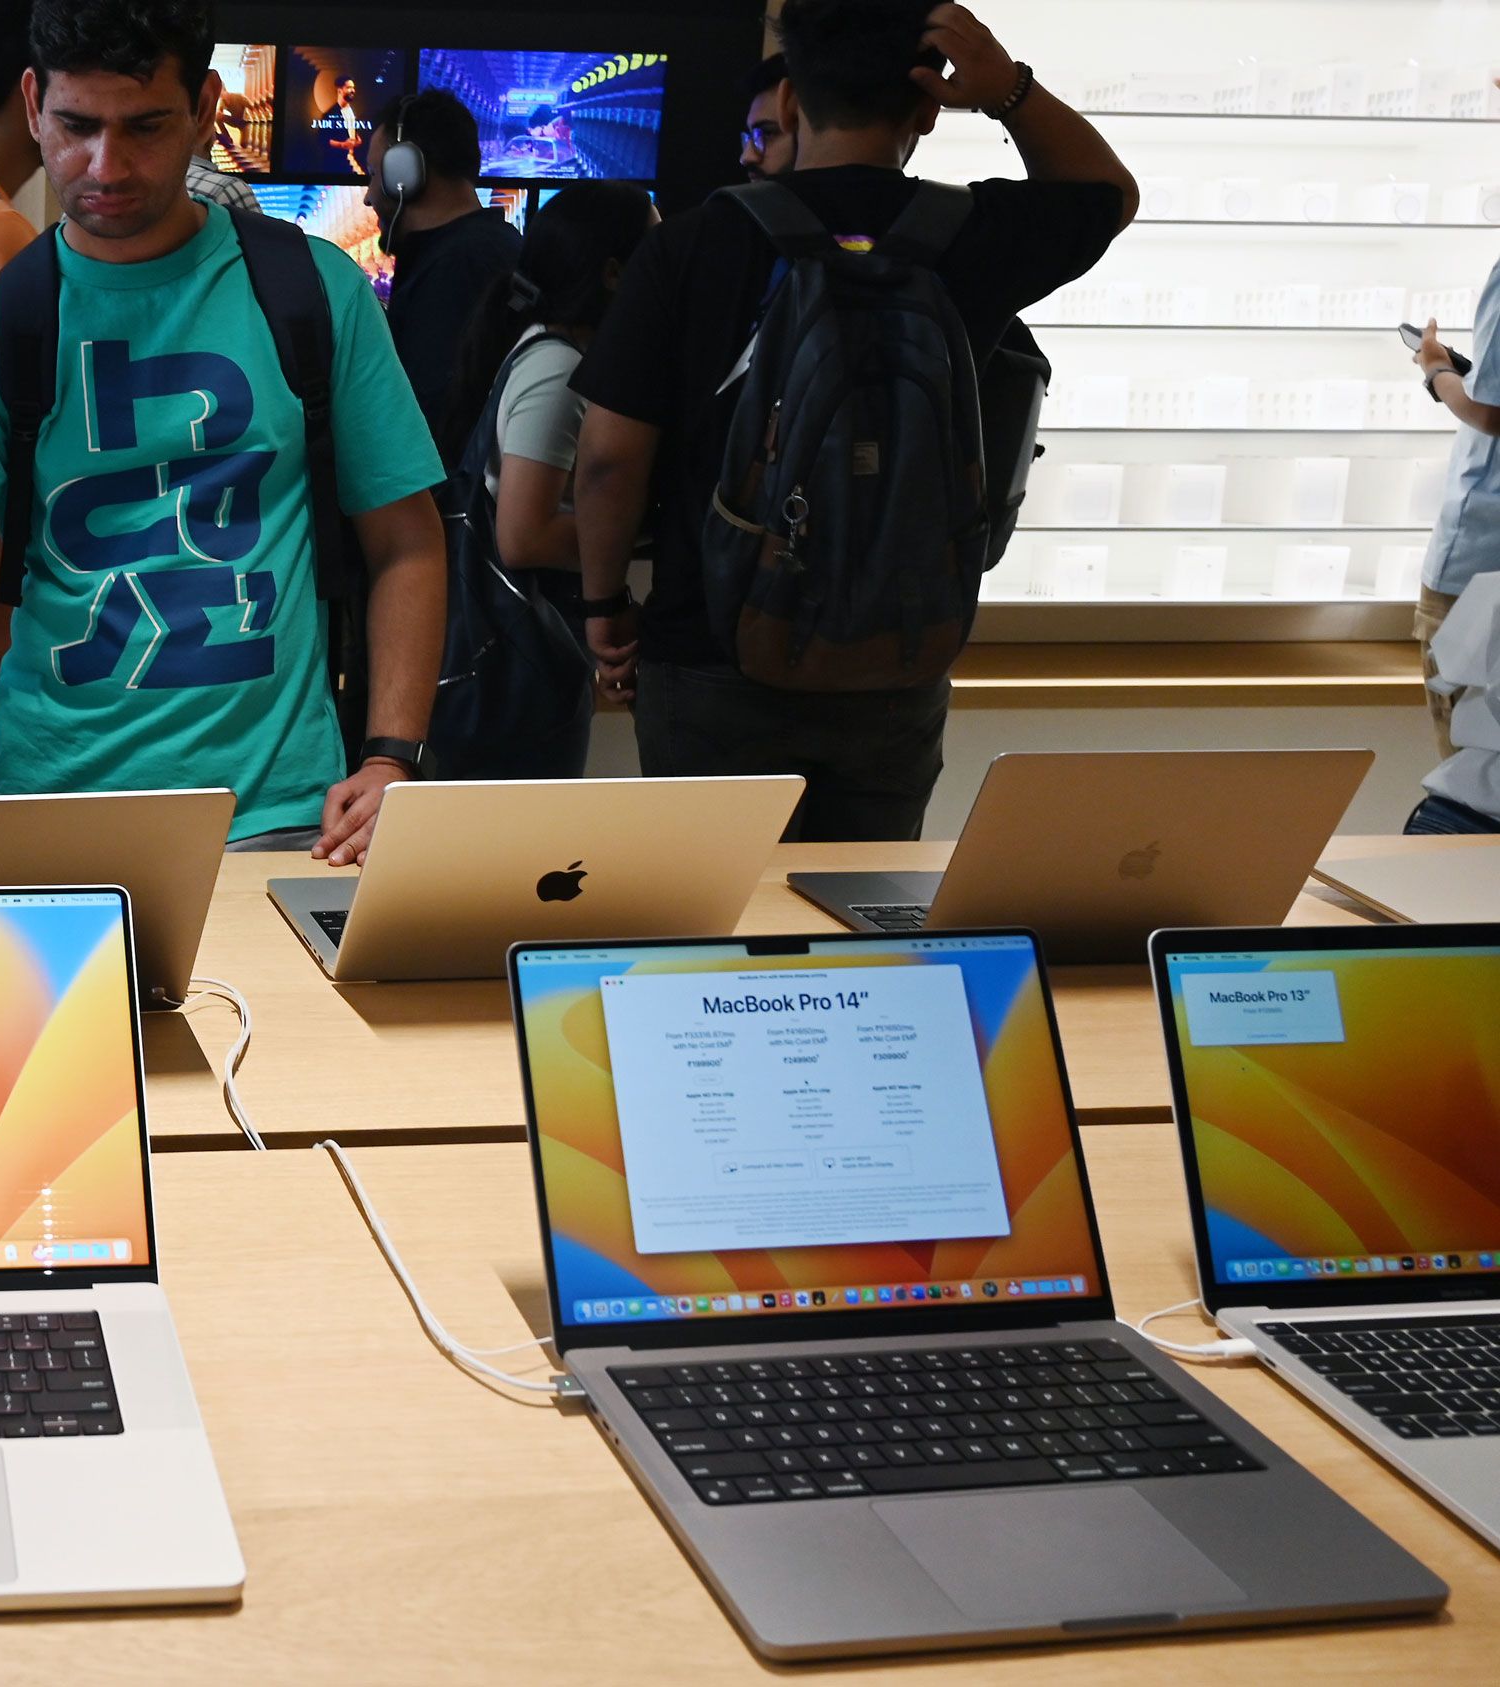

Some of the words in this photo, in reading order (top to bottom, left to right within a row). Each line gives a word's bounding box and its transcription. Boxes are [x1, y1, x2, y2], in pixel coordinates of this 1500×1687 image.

[702, 994, 795, 1014] MacBook
[800, 993, 832, 1011] Pro
[1210, 991, 1266, 1003] MacBook
[1268, 991, 1288, 1002] Pro
